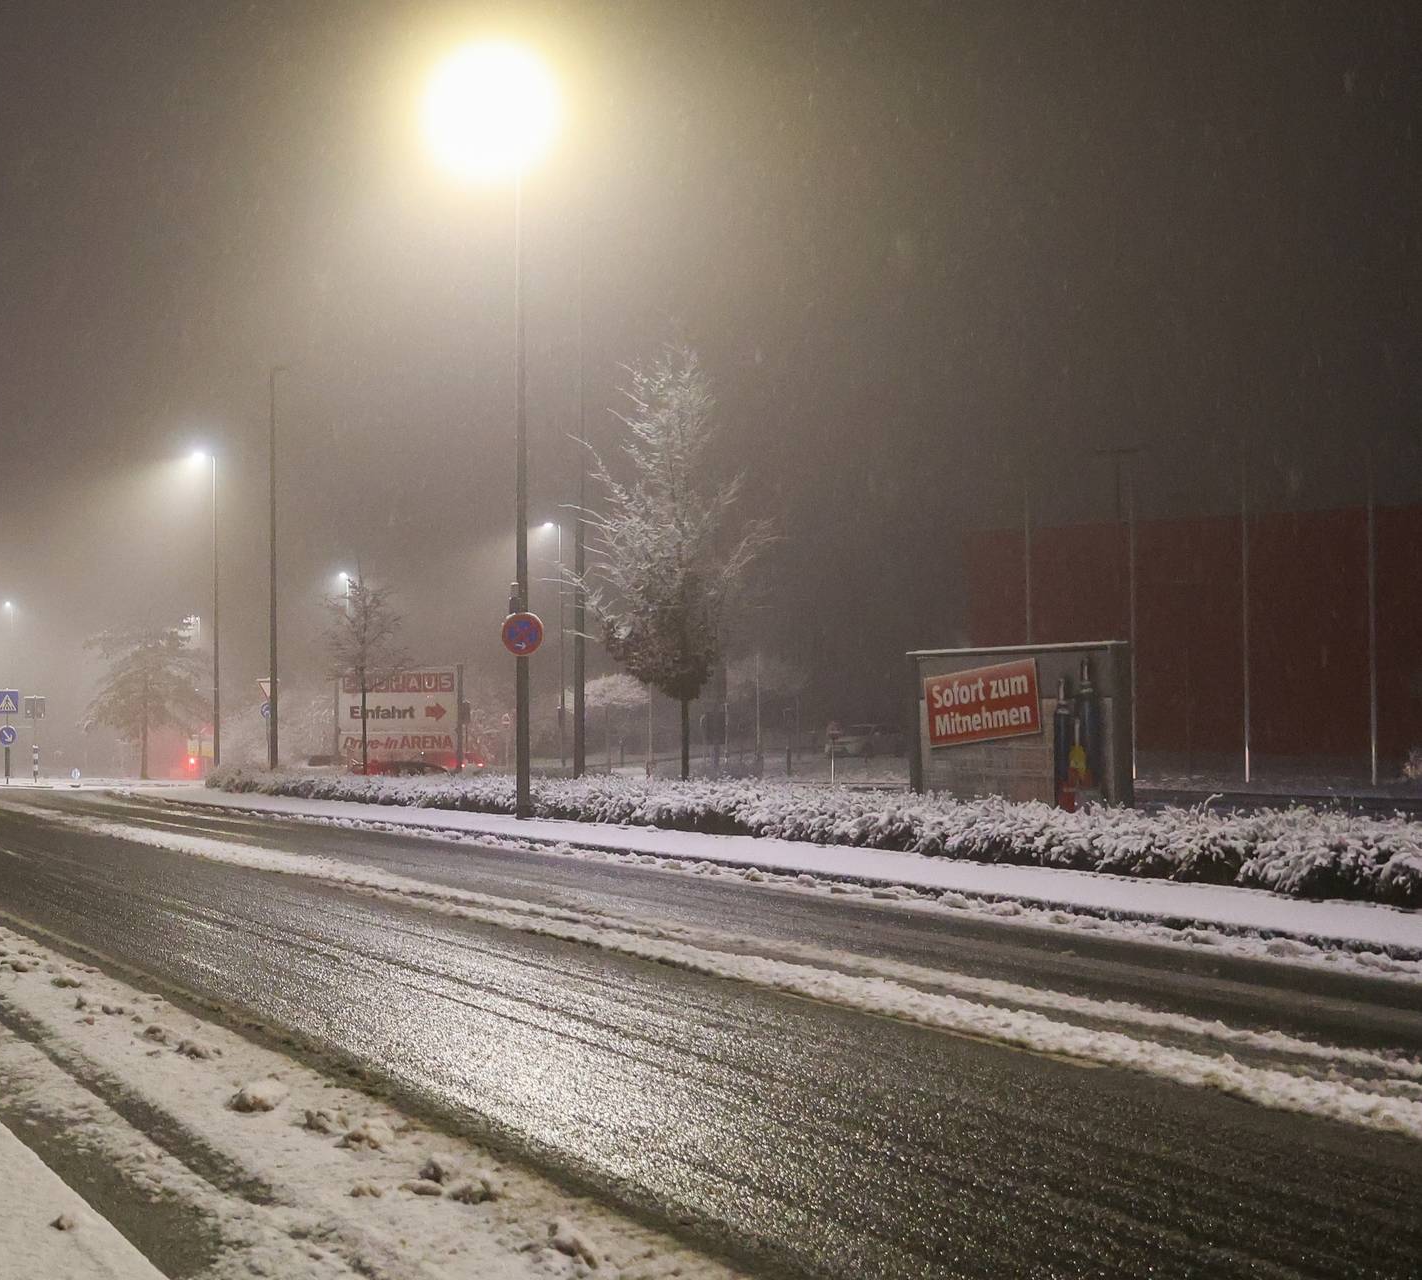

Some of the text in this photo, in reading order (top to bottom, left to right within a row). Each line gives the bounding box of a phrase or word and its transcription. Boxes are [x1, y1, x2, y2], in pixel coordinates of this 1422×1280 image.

[343, 674, 453, 691] BUHAUS
[932, 674, 1029, 709] Sofort zum
[349, 705, 415, 719] Enfahrt
[934, 704, 1032, 737] Mitnehmen
[400, 735, 454, 750] ARENA
